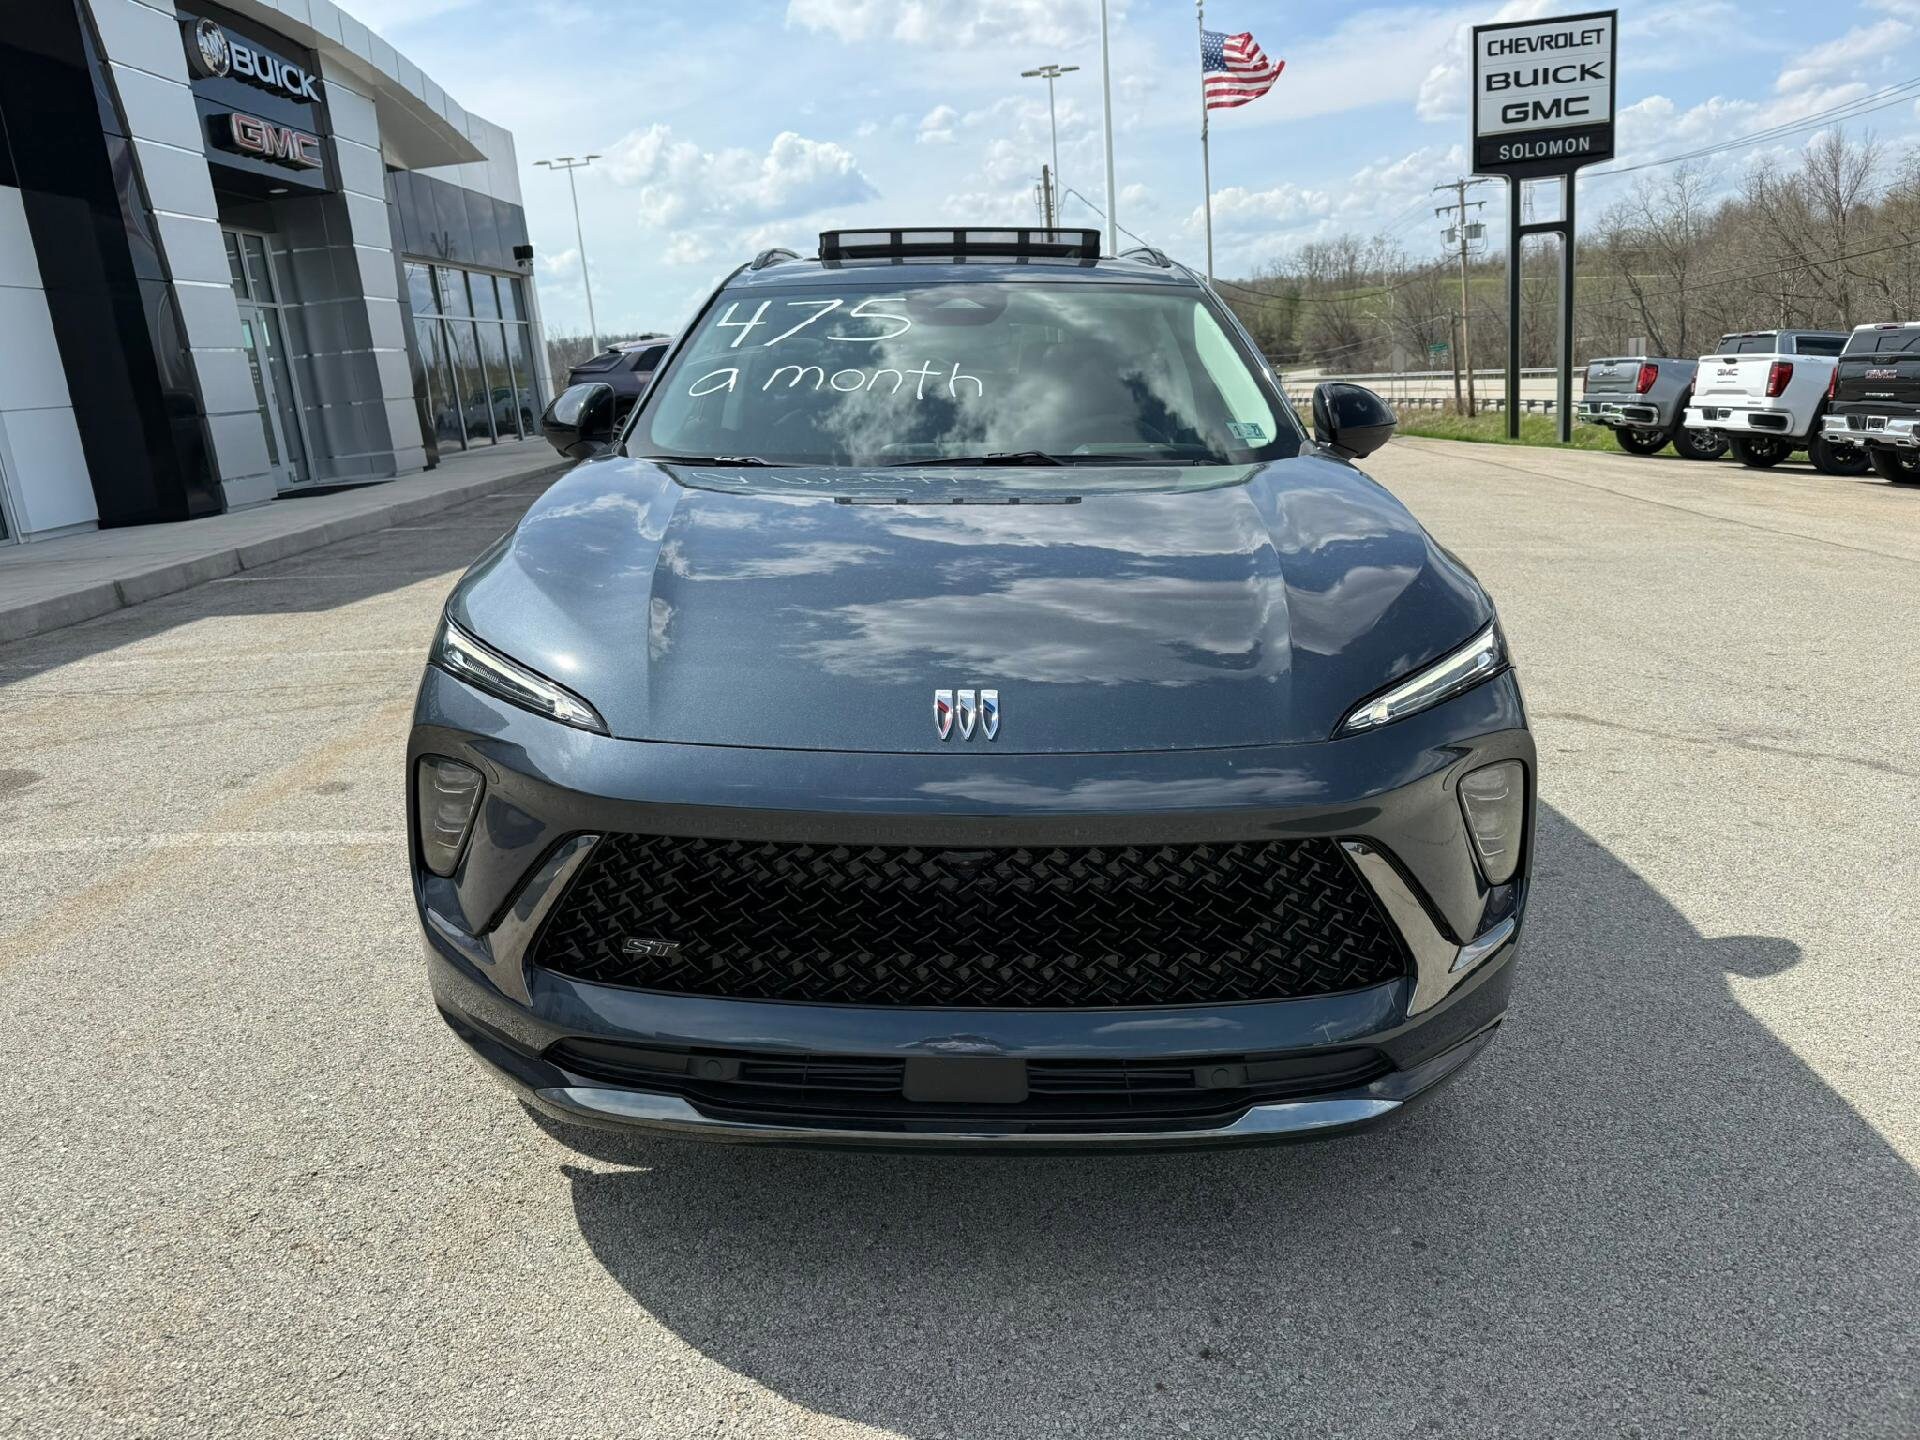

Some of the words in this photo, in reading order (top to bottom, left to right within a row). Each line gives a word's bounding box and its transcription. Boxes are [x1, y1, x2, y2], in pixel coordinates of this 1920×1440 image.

[1487, 28, 1605, 57] CHEVROLET
[229, 41, 321, 103] BUICK
[1486, 61, 1606, 92] BUICK
[1501, 96, 1590, 124] GMC
[231, 112, 322, 168] GMC
[1499, 136, 1590, 160] SOLOMON
[716, 298, 911, 347] 475
[688, 367, 739, 397] a
[762, 360, 984, 399] month
[622, 938, 680, 956] ST
